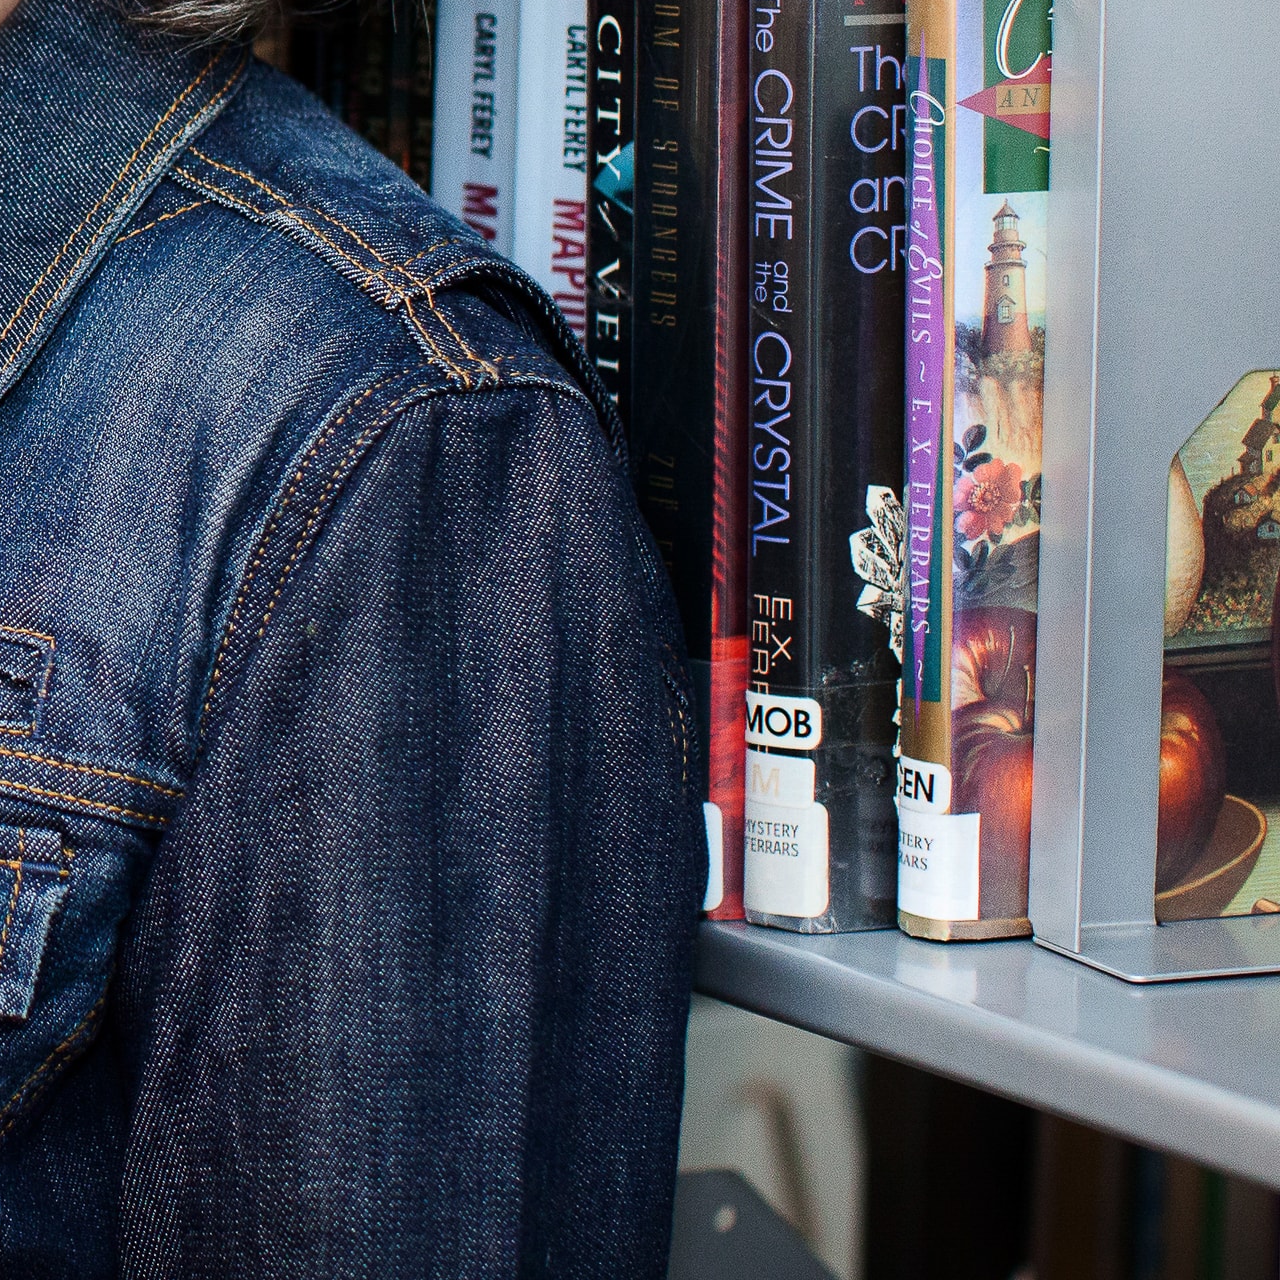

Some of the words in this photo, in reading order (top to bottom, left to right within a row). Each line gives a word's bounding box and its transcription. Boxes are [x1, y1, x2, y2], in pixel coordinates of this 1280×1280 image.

[471, 13, 498, 83] CARYL
[849, 45, 905, 93] Th
[470, 92, 496, 160] FÉREY
[596, 15, 622, 181] CITY
[653, 77, 679, 111] OF
[998, 88, 1041, 109] AN
[753, 67, 793, 240] CRIME
[909, 89, 946, 211] CHOICE
[649, 139, 679, 328] STRANGERS
[754, 261, 772, 304] the
[771, 261, 794, 312] and
[908, 244, 943, 345] EVILS
[751, 331, 791, 558] CRYSTAL
[910, 482, 932, 635] FERRARS
[745, 704, 812, 738] MOB
[751, 763, 780, 798] M
[899, 766, 934, 804] EN
